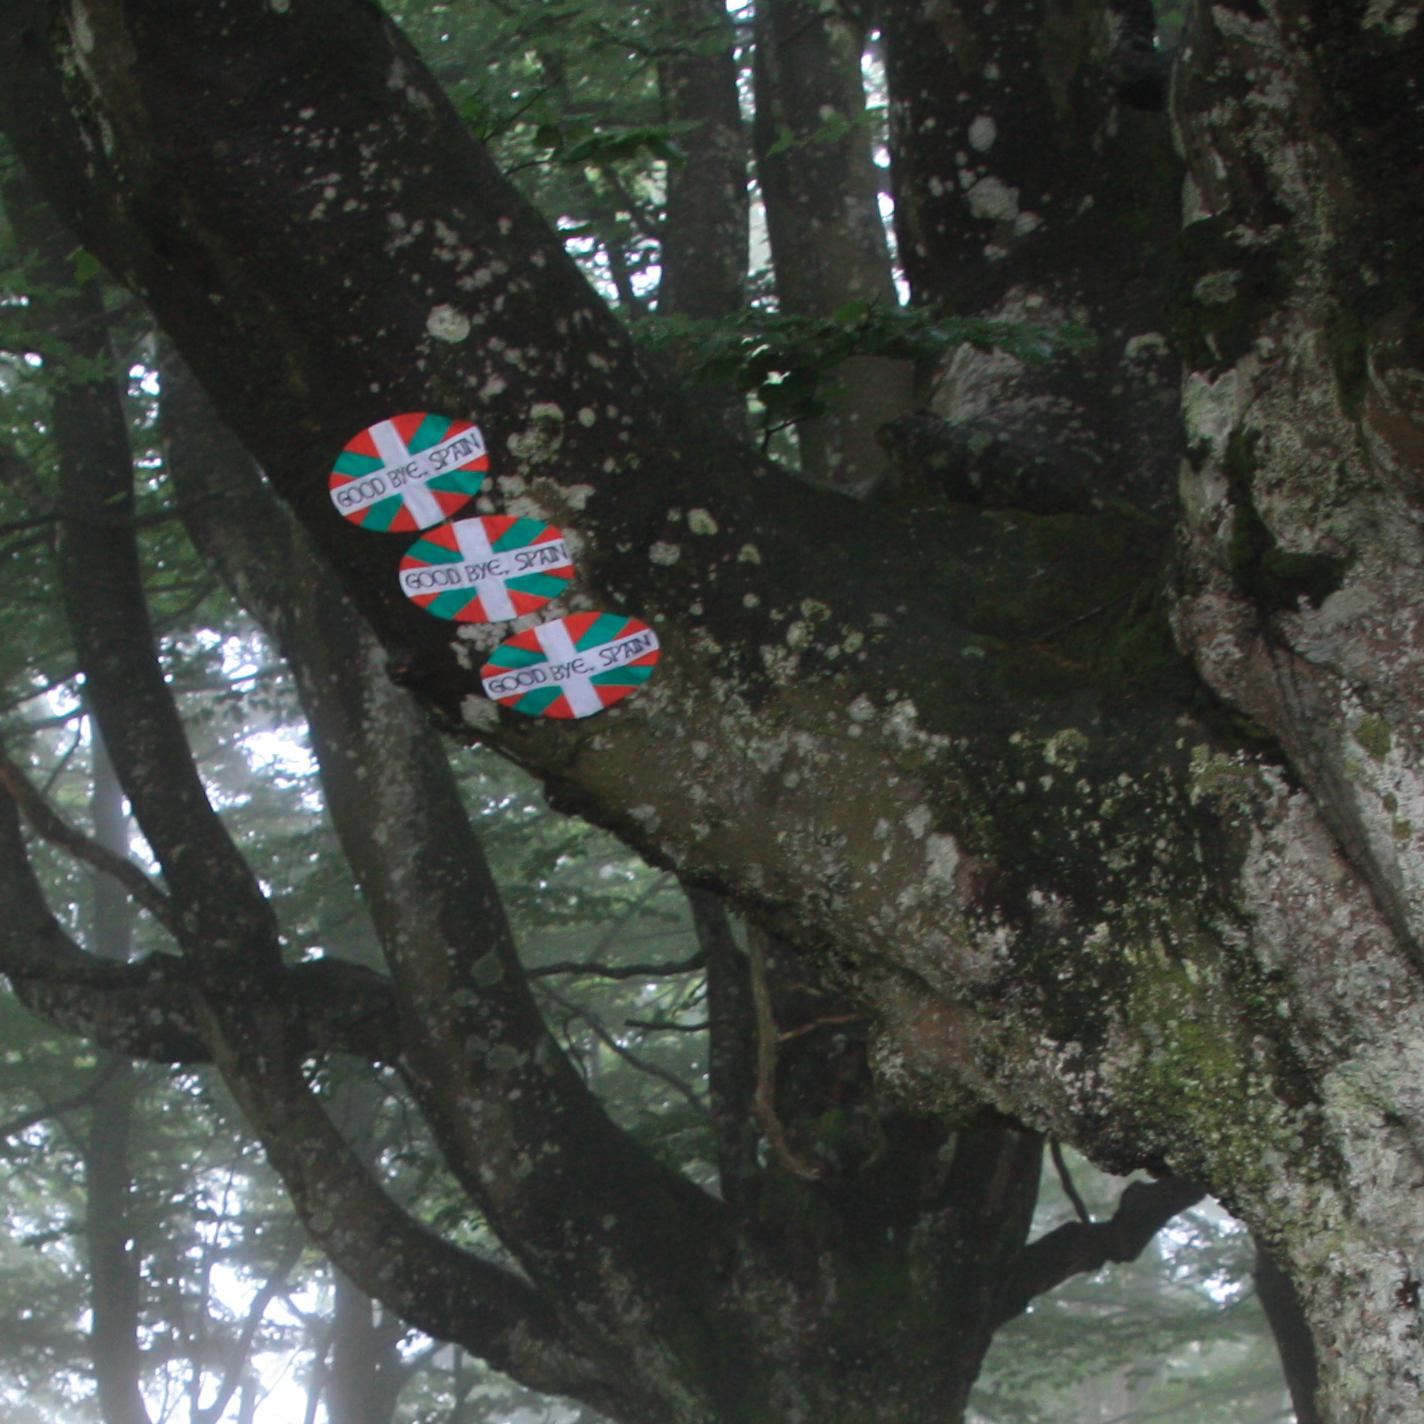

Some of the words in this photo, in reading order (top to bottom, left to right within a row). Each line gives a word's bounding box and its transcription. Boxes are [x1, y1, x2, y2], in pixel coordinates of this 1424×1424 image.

[336, 480, 385, 508] GOOD
[429, 432, 482, 471] SPAIN
[405, 562, 461, 589] GOOD
[514, 543, 568, 570] SPAIN
[488, 668, 548, 694] GOOD
[598, 633, 652, 667] SPAIN
